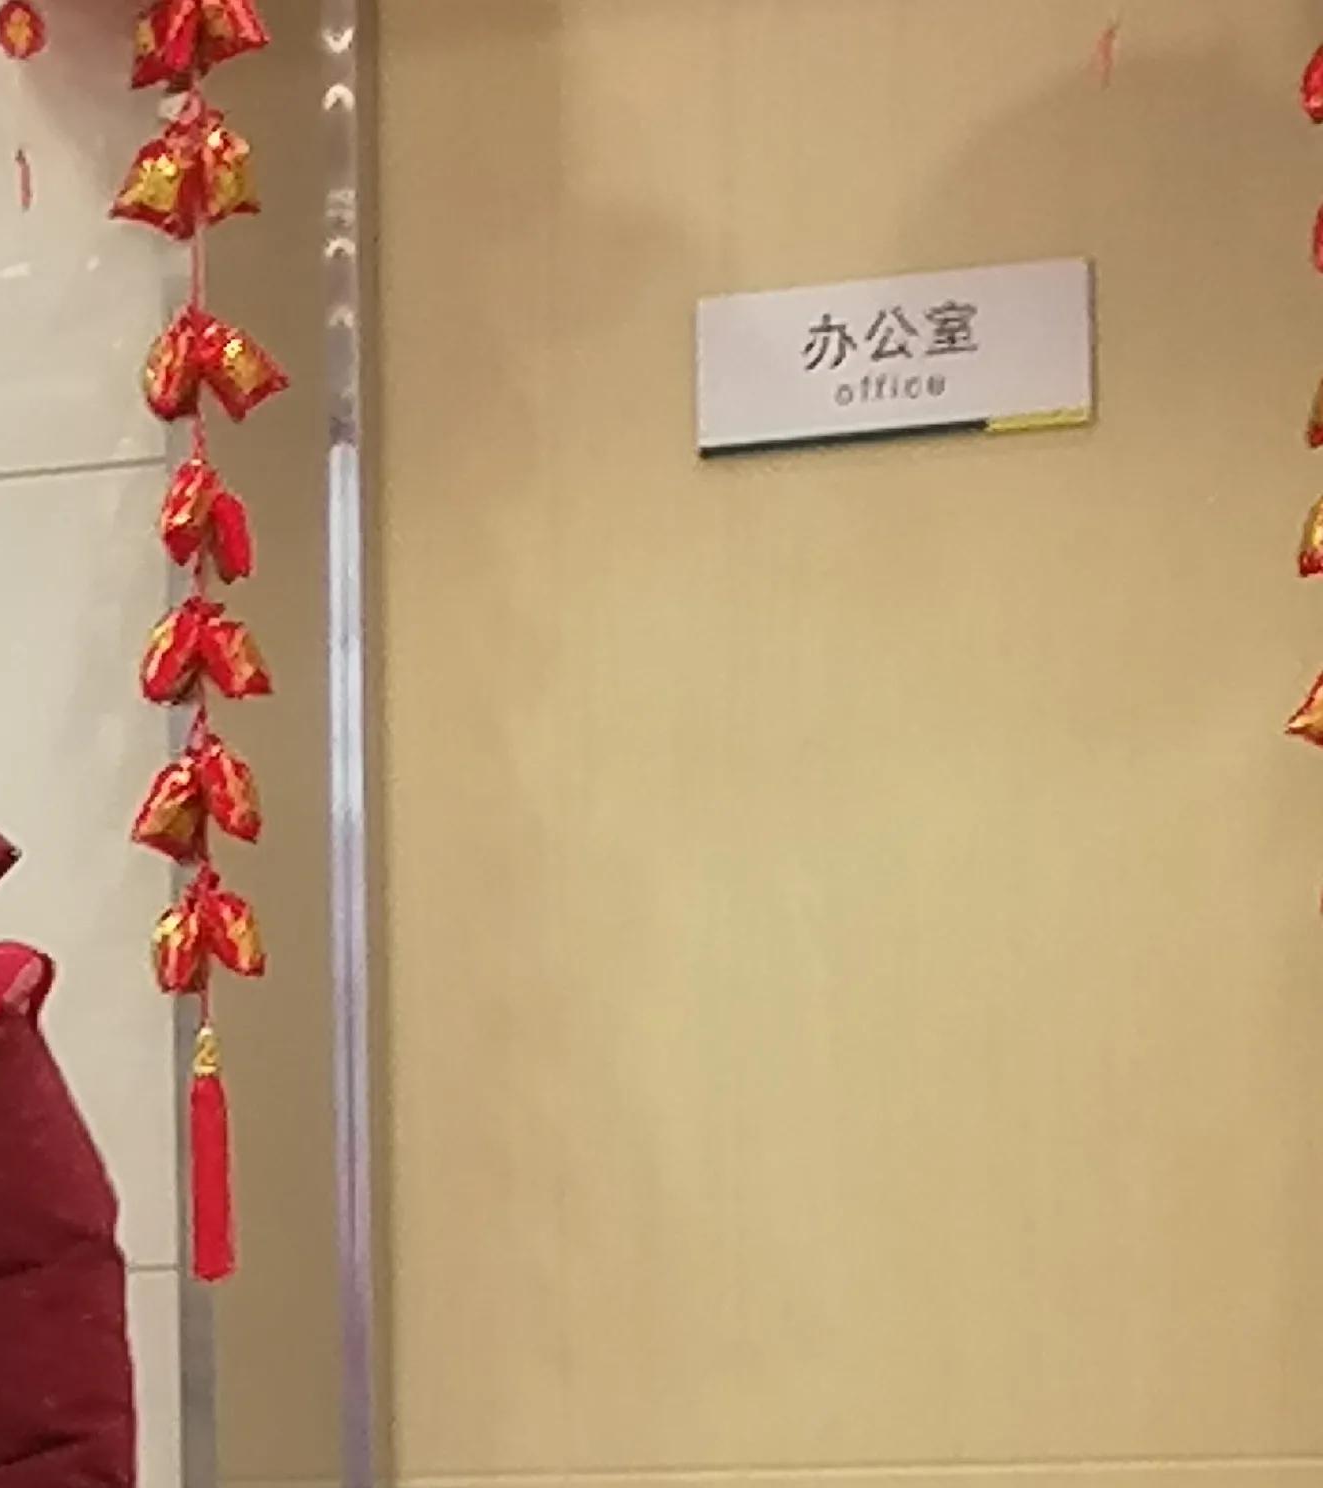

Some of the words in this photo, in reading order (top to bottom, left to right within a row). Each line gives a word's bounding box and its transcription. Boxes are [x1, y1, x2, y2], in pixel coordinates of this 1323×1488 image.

[801, 300, 979, 371] 办公室
[834, 373, 946, 406] office
